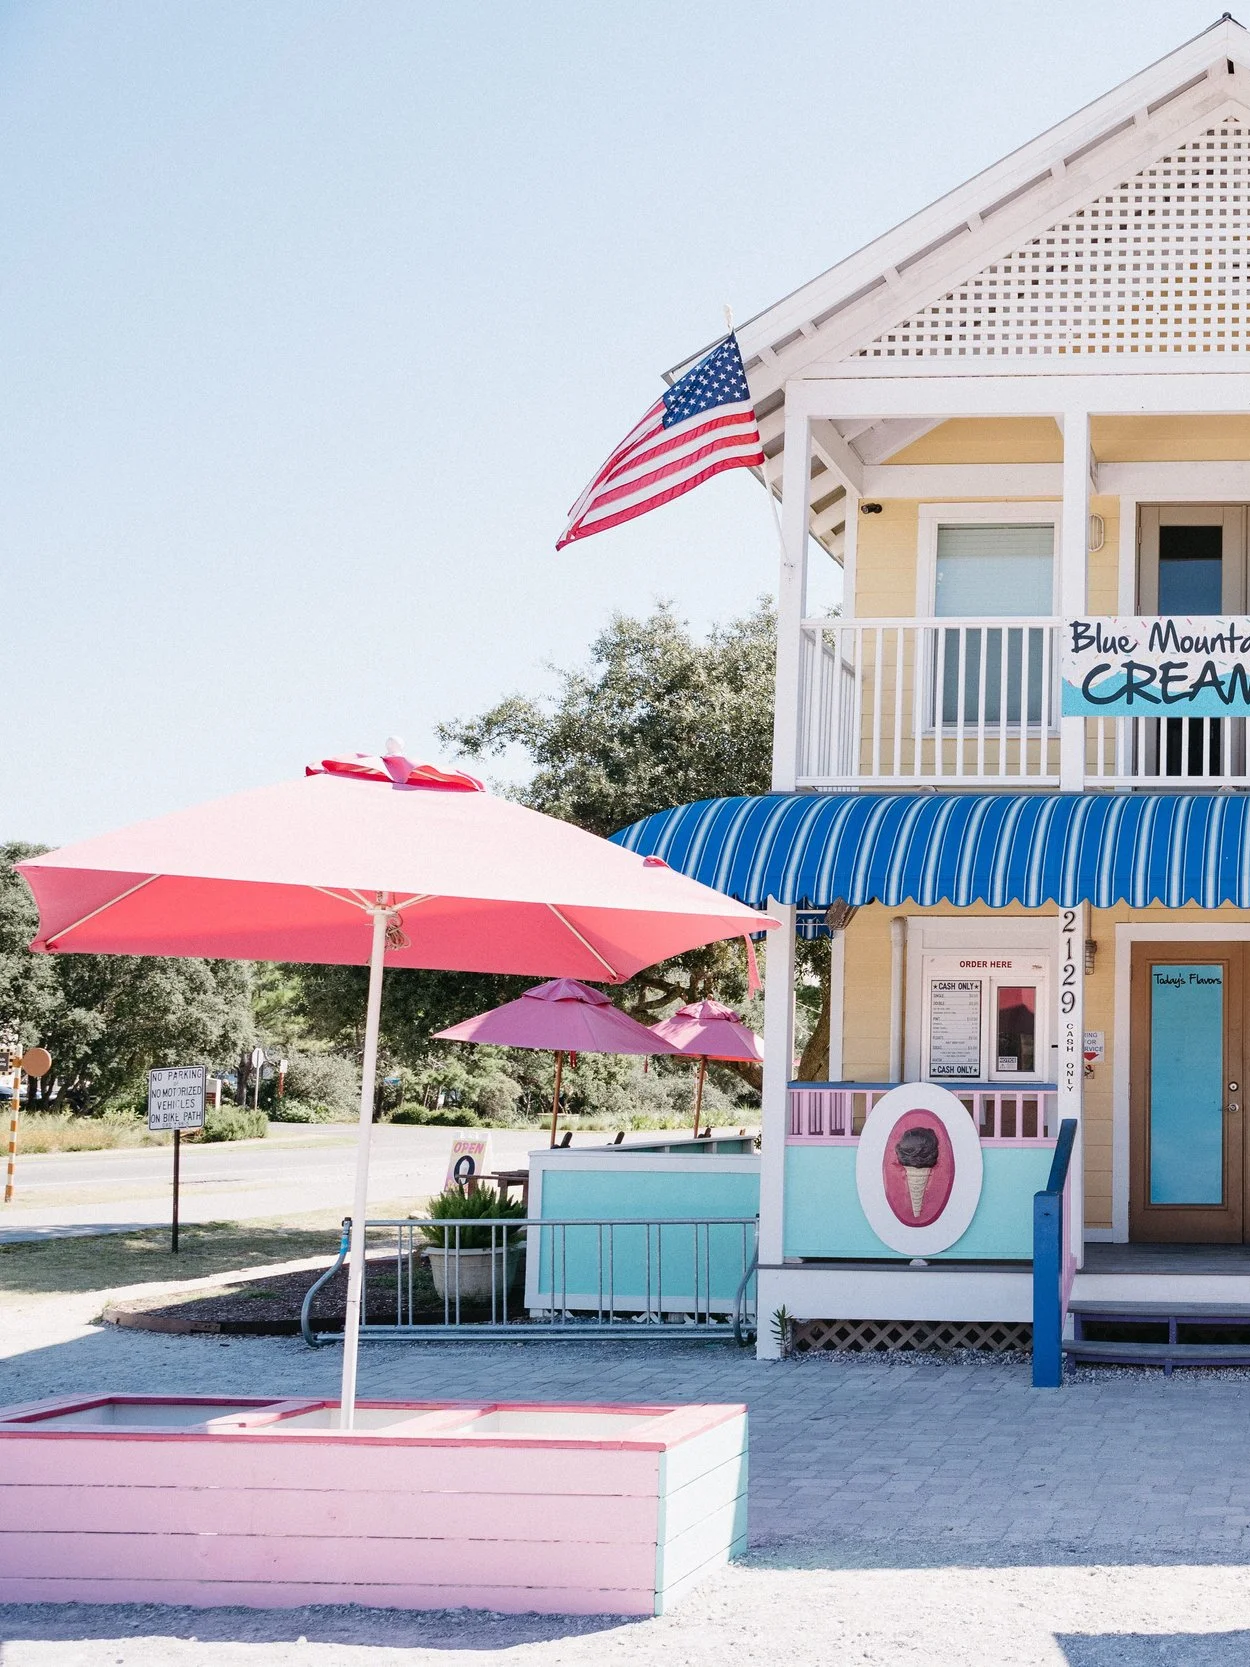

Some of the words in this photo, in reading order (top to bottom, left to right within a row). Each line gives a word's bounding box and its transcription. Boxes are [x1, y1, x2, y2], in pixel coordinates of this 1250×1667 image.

[1070, 620, 1138, 654] Blue
[990, 960, 1012, 968] HERE
[1062, 911, 1076, 1014] 2129
[1153, 973, 1186, 988] Today's
[1189, 973, 1222, 984] Flavors
[152, 1072, 162, 1082] NO
[168, 1069, 202, 1080] PARKING
[1066, 1062, 1074, 1092] ONLY
[151, 1114, 160, 1123] ON
[164, 1113, 179, 1122] BIKE
[184, 1111, 201, 1120] PATH
[453, 1141, 484, 1154] OPEN
